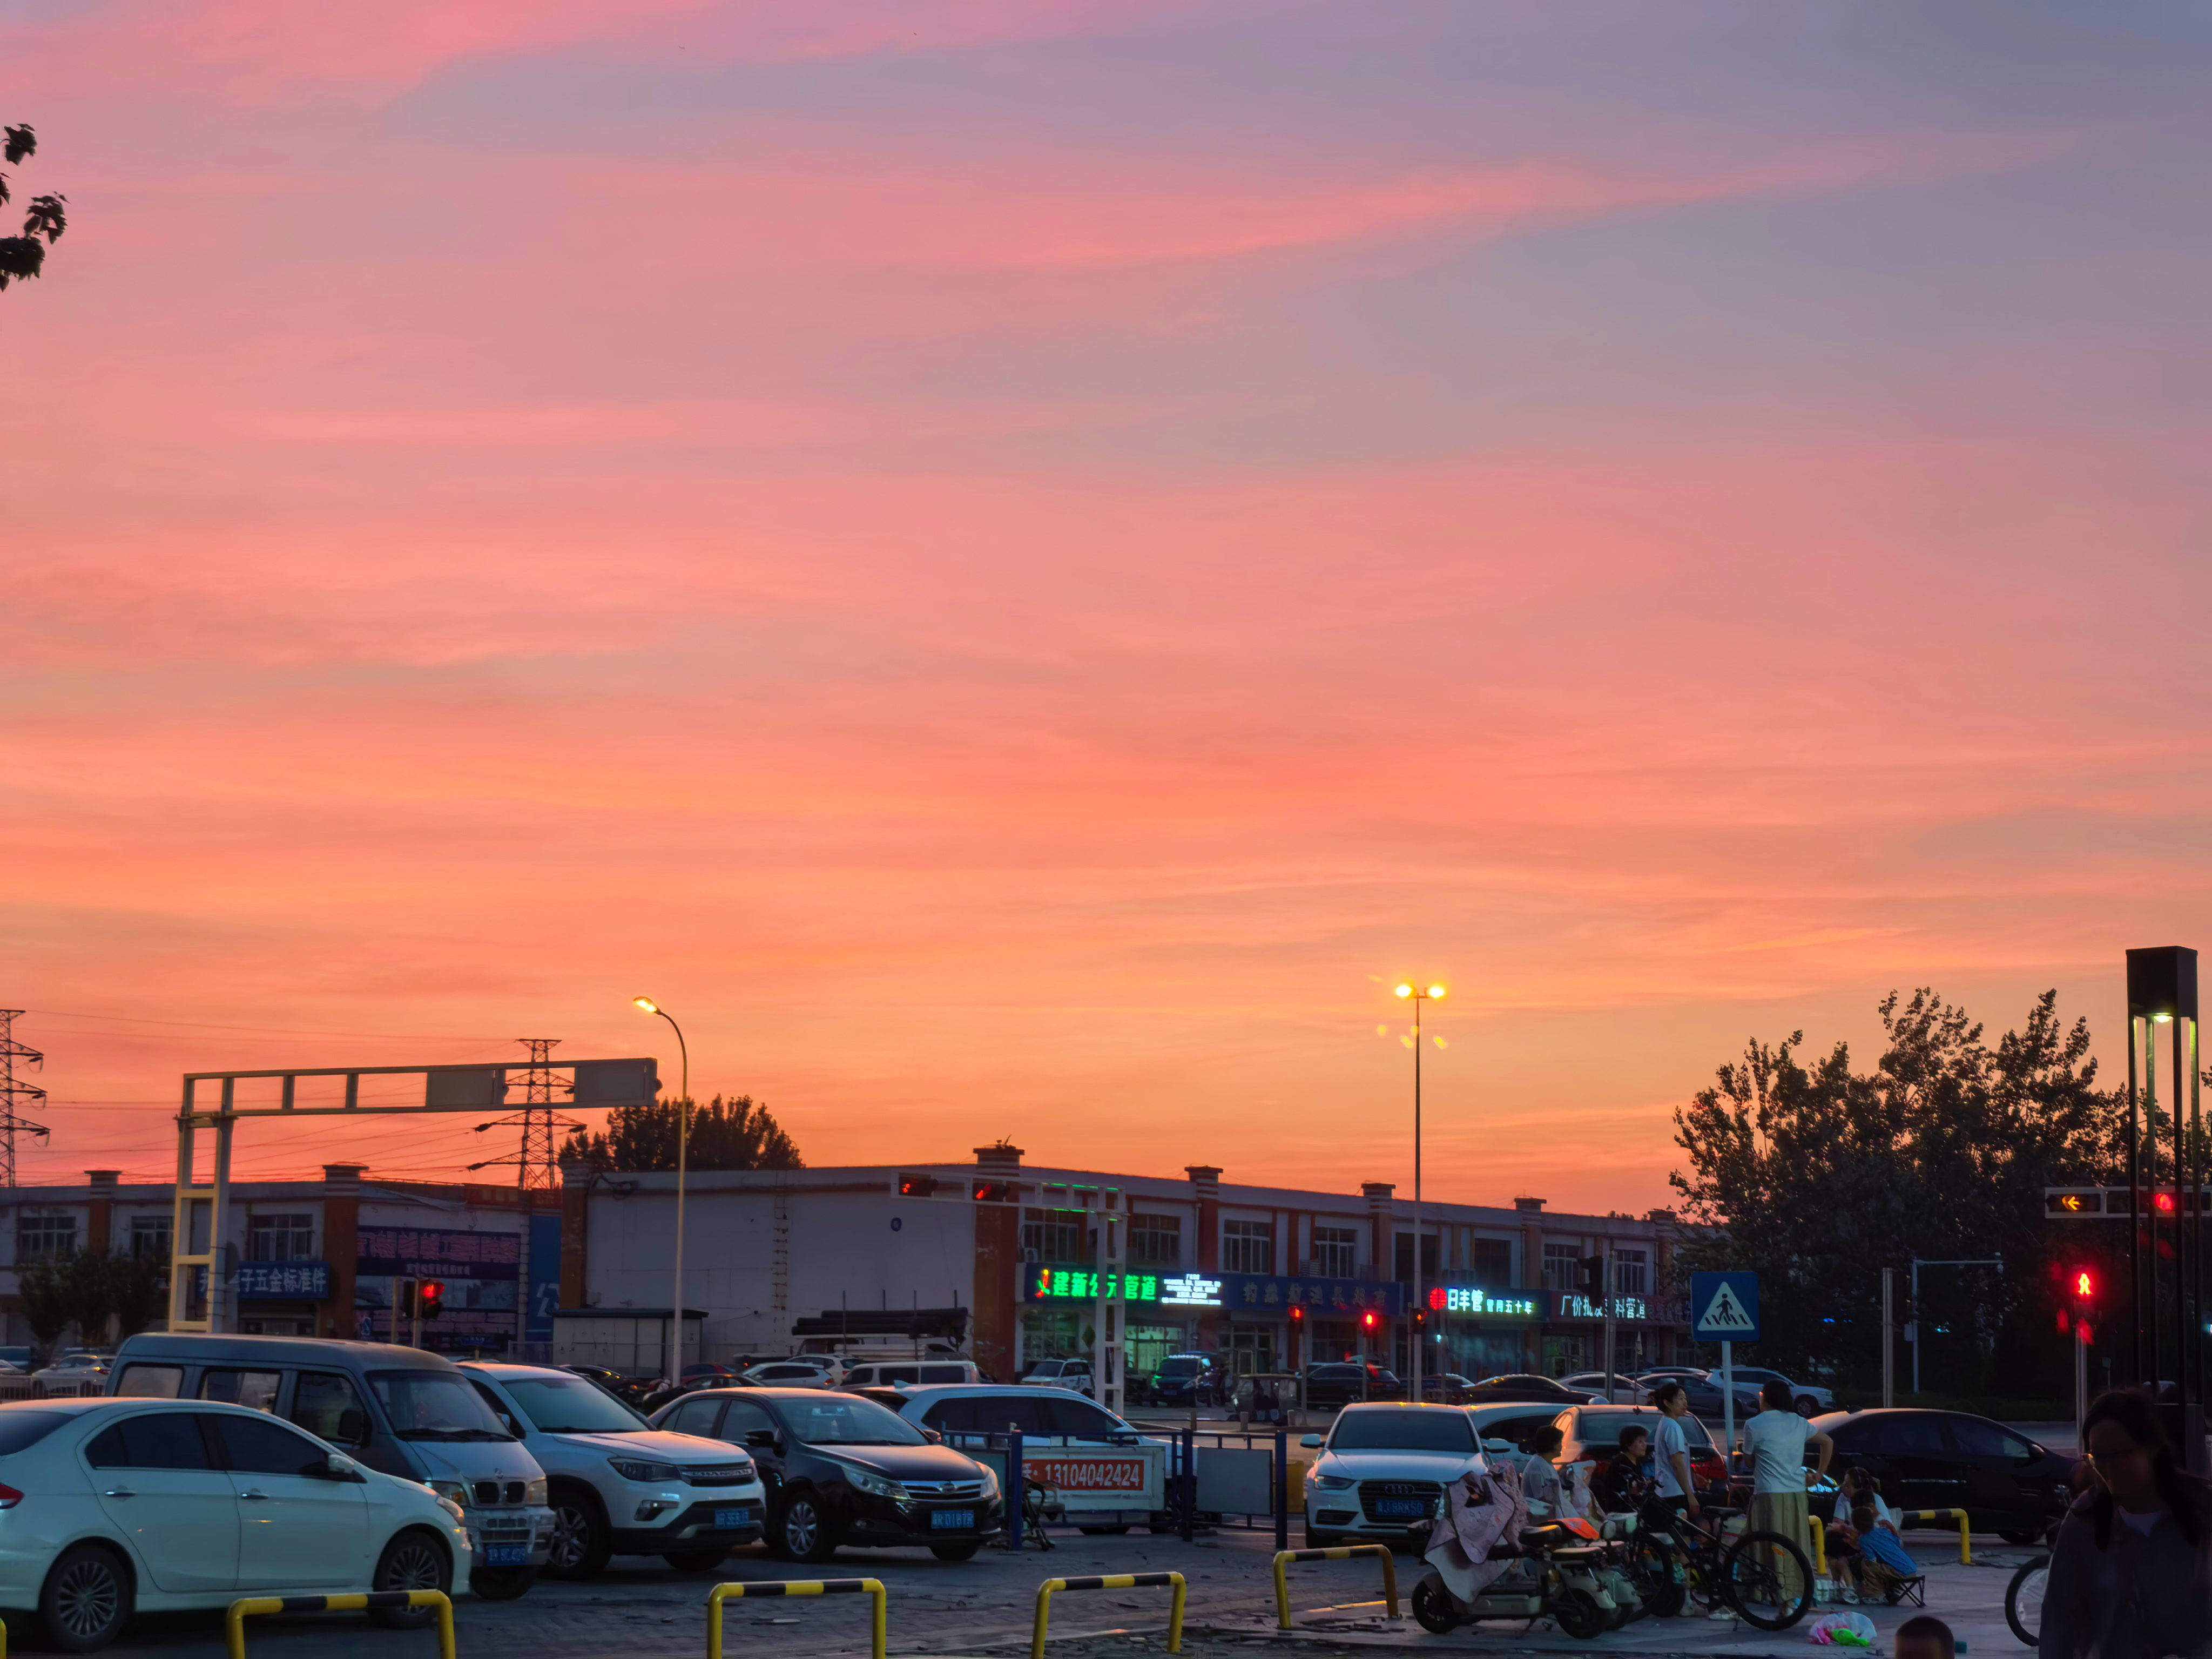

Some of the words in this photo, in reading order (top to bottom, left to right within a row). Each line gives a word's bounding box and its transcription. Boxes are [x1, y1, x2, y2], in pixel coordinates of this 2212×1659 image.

[1448, 1288, 1483, 1312] 日丰管
[1046, 1463, 1140, 1487] 13104042424
